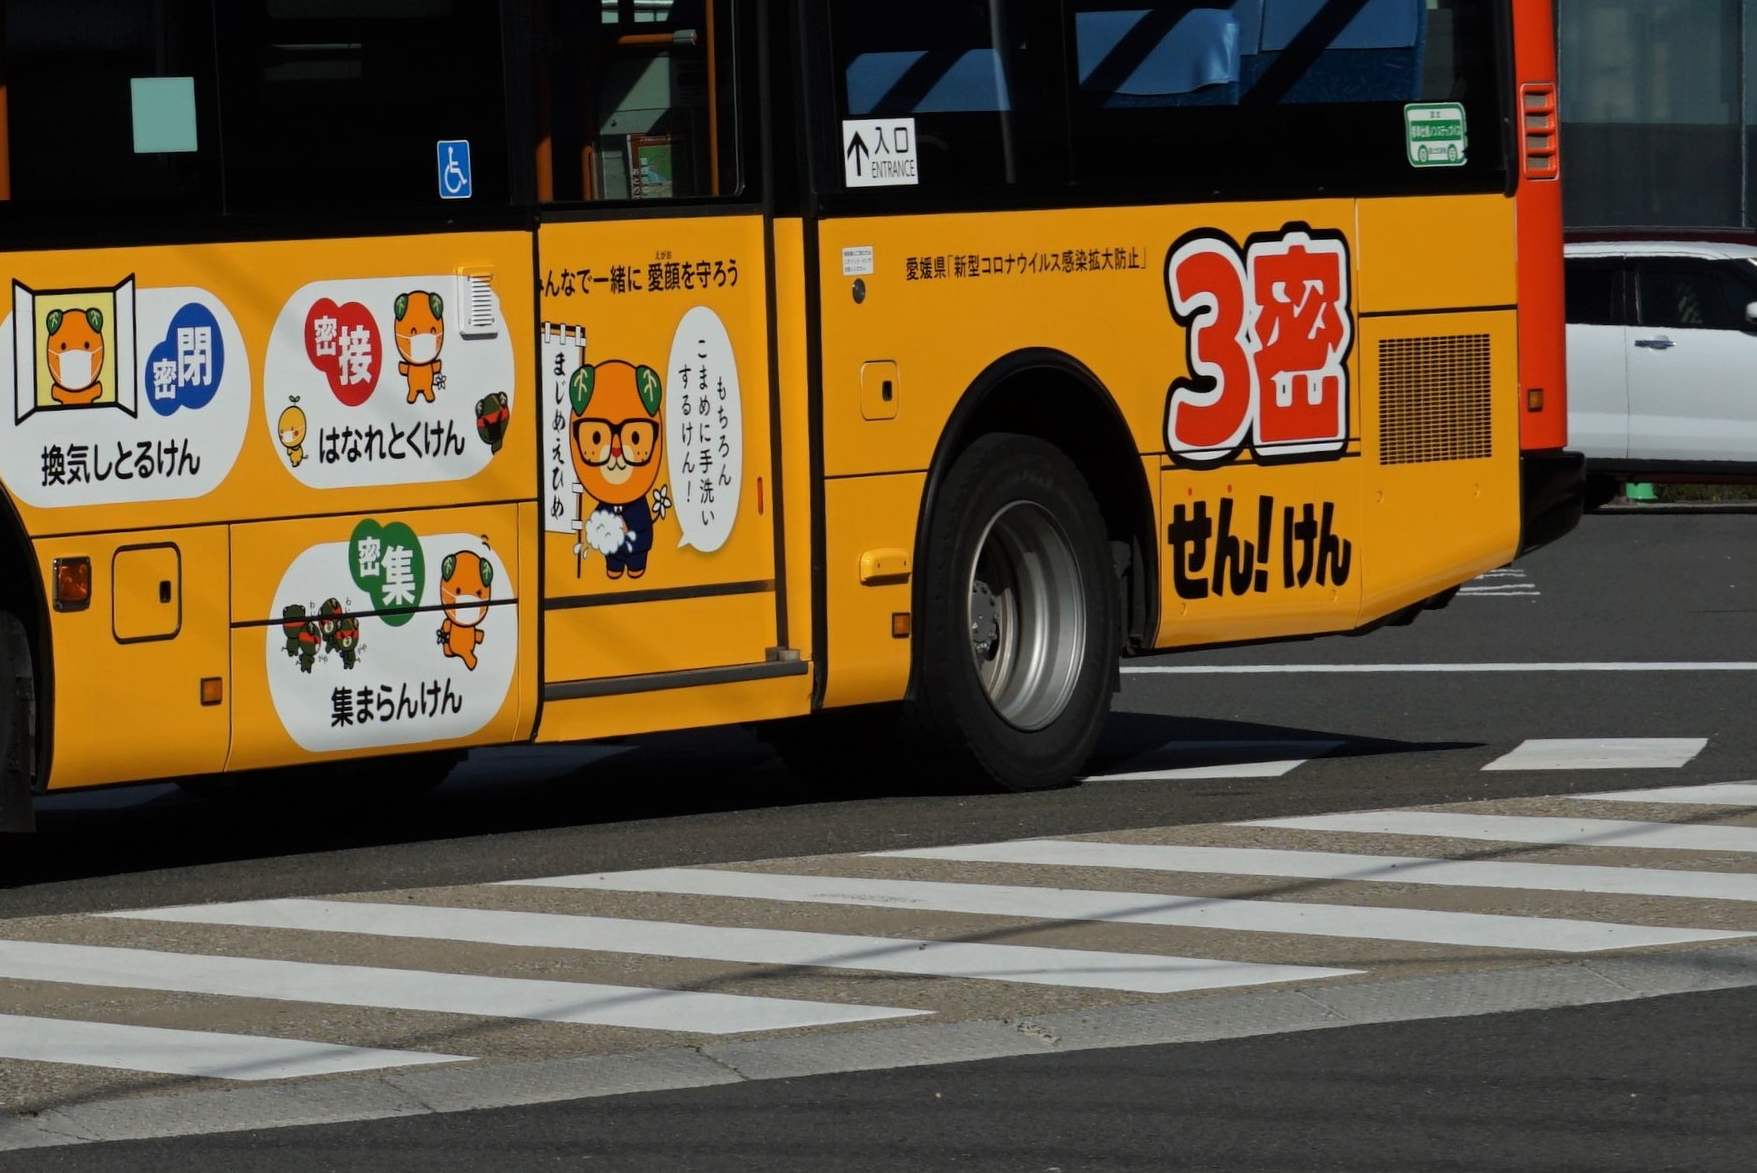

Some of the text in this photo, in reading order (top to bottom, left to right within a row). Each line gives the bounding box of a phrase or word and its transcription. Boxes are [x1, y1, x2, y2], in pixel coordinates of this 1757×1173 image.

[874, 126, 909, 154] 入口
[871, 159, 916, 179] ENTRANCE
[540, 265, 642, 298] んなで一緒に
[1168, 229, 1348, 462] 3密
[318, 420, 465, 464] はなれとくけん
[550, 352, 566, 521] まじめえひめ
[678, 364, 695, 503] するけん!
[697, 339, 715, 526] こまめに手洗い
[716, 376, 731, 486] もちろん
[40, 438, 201, 487] 換気しとるけん
[330, 679, 463, 728] 集まらんけん
